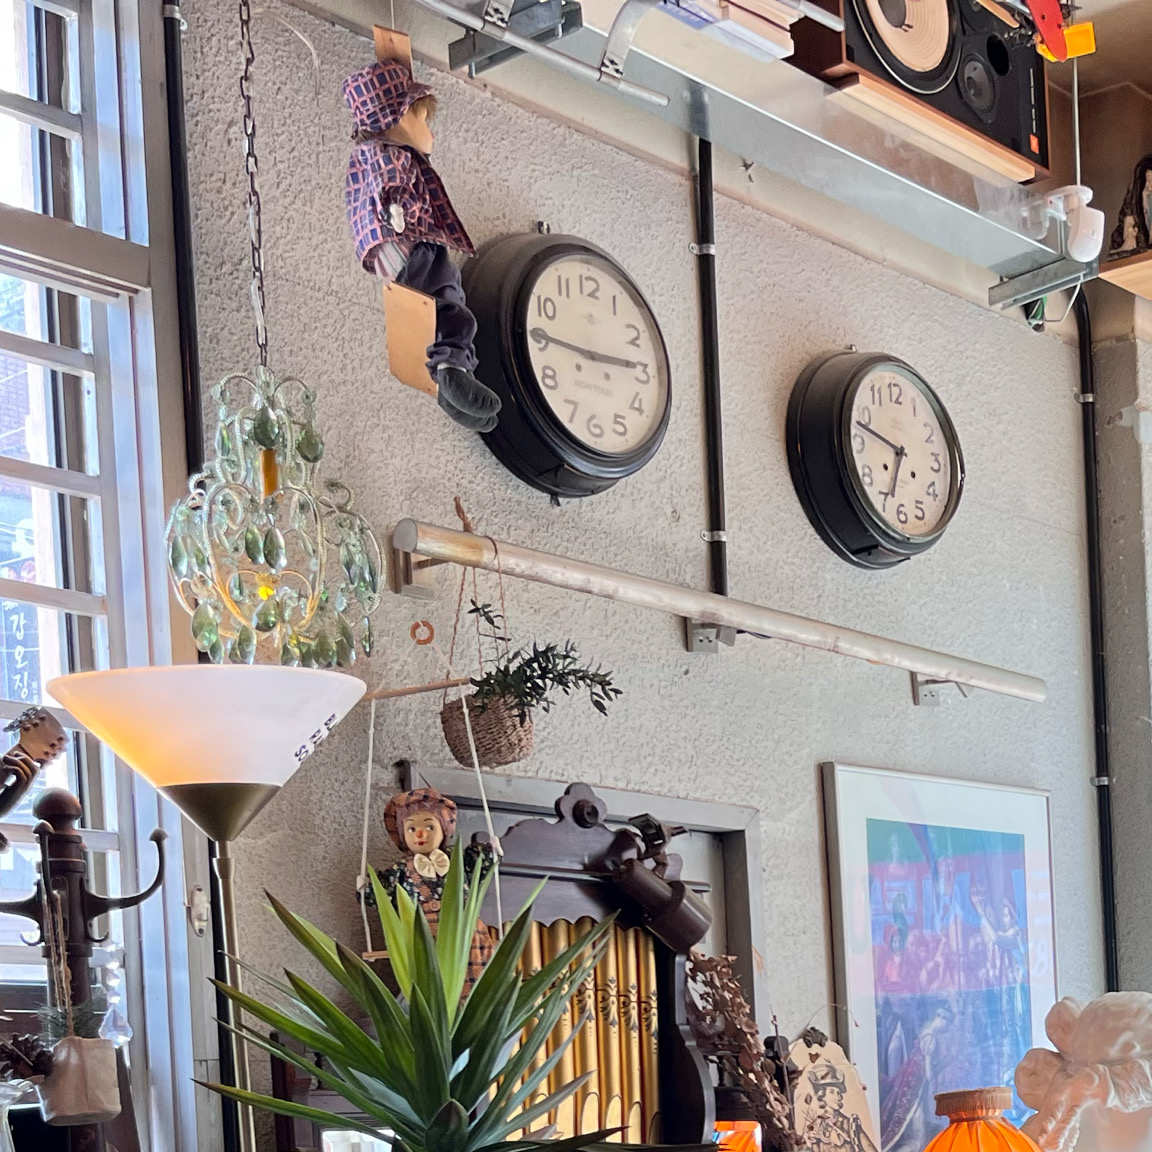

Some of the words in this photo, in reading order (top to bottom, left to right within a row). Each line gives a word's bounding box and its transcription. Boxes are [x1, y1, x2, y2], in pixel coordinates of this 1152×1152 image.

[557, 274, 570, 299] 11
[579, 273, 600, 300] 12
[537, 294, 557, 320] 10
[612, 295, 617, 316] 1
[625, 324, 641, 348] 2
[541, 366, 558, 390] 8
[634, 361, 650, 385] 3
[629, 392, 645, 416] 4
[870, 384, 882, 407] 11
[887, 382, 903, 405] 12
[563, 399, 580, 423] 7
[586, 414, 604, 438] 6
[612, 413, 628, 436] 5
[923, 422, 934, 444] 2
[930, 452, 941, 474] 3
[861, 465, 873, 487] 8
[878, 491, 889, 513] 7
[926, 481, 939, 502] 4
[896, 503, 908, 524] 6
[914, 500, 925, 521] 5
